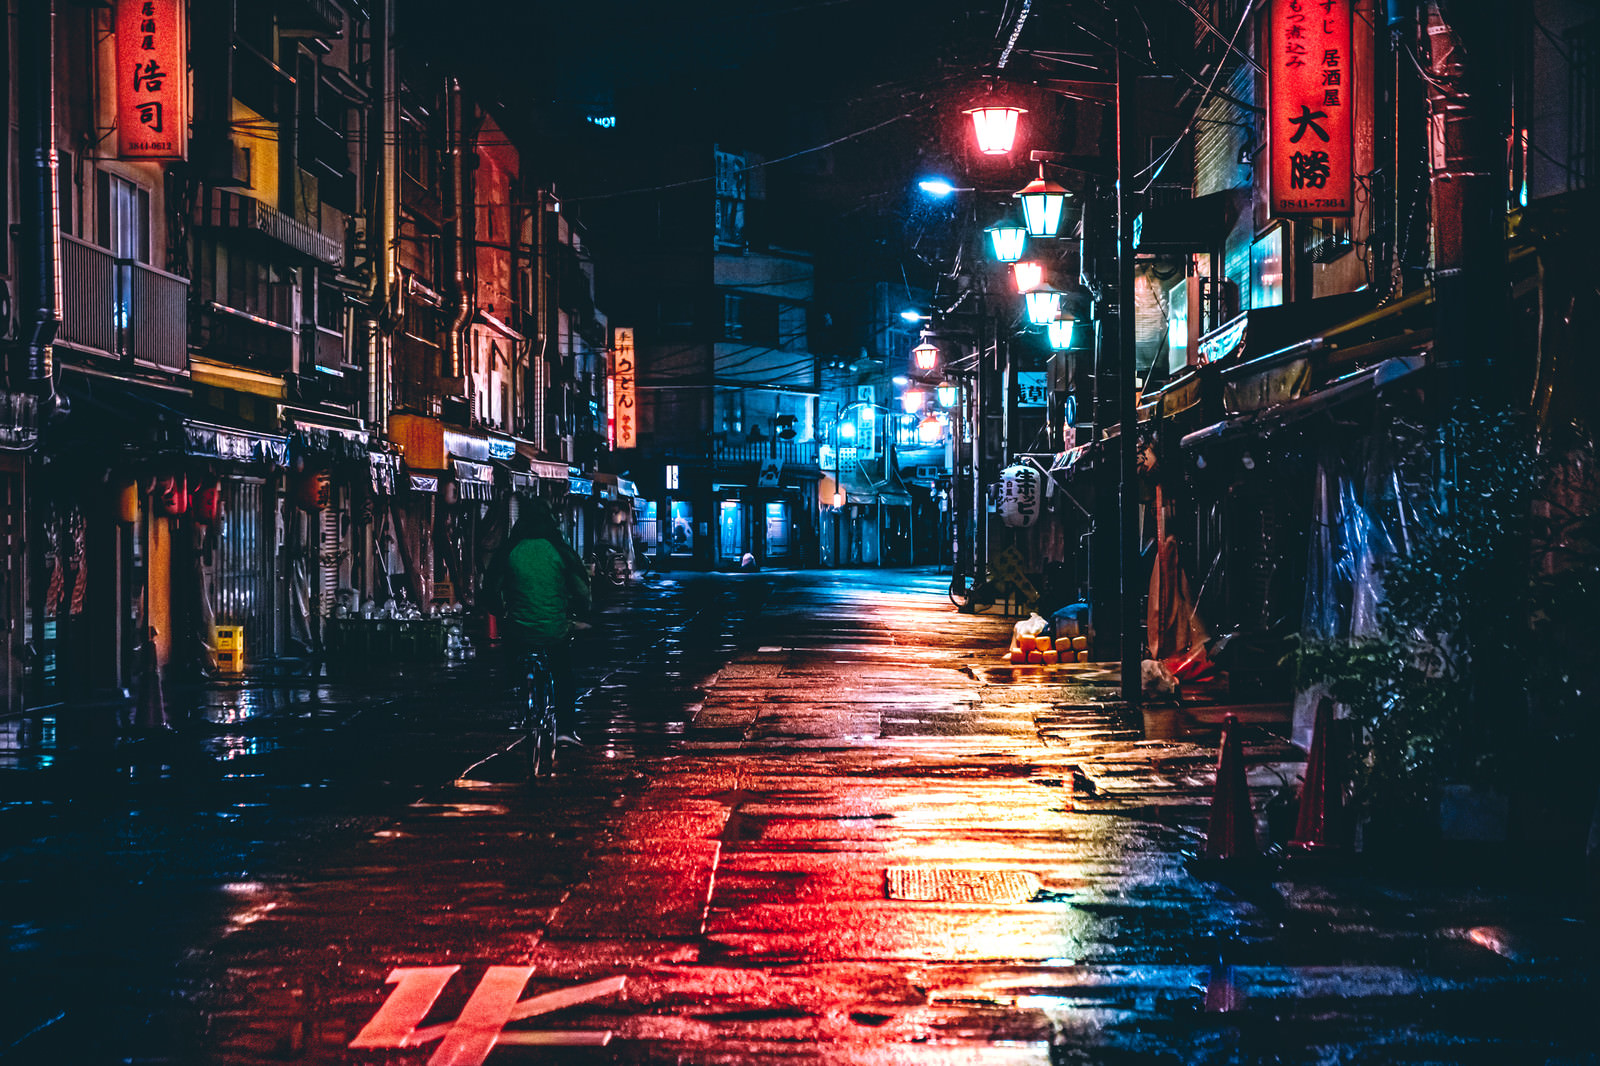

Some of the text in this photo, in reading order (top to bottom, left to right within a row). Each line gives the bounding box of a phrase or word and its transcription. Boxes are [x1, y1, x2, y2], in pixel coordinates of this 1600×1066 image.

[141, 2, 156, 50] 居酒屋
[133, 59, 167, 133] 浩司
[1321, 49, 1341, 107] 居酒屋
[1288, 105, 1331, 190] 大勝
